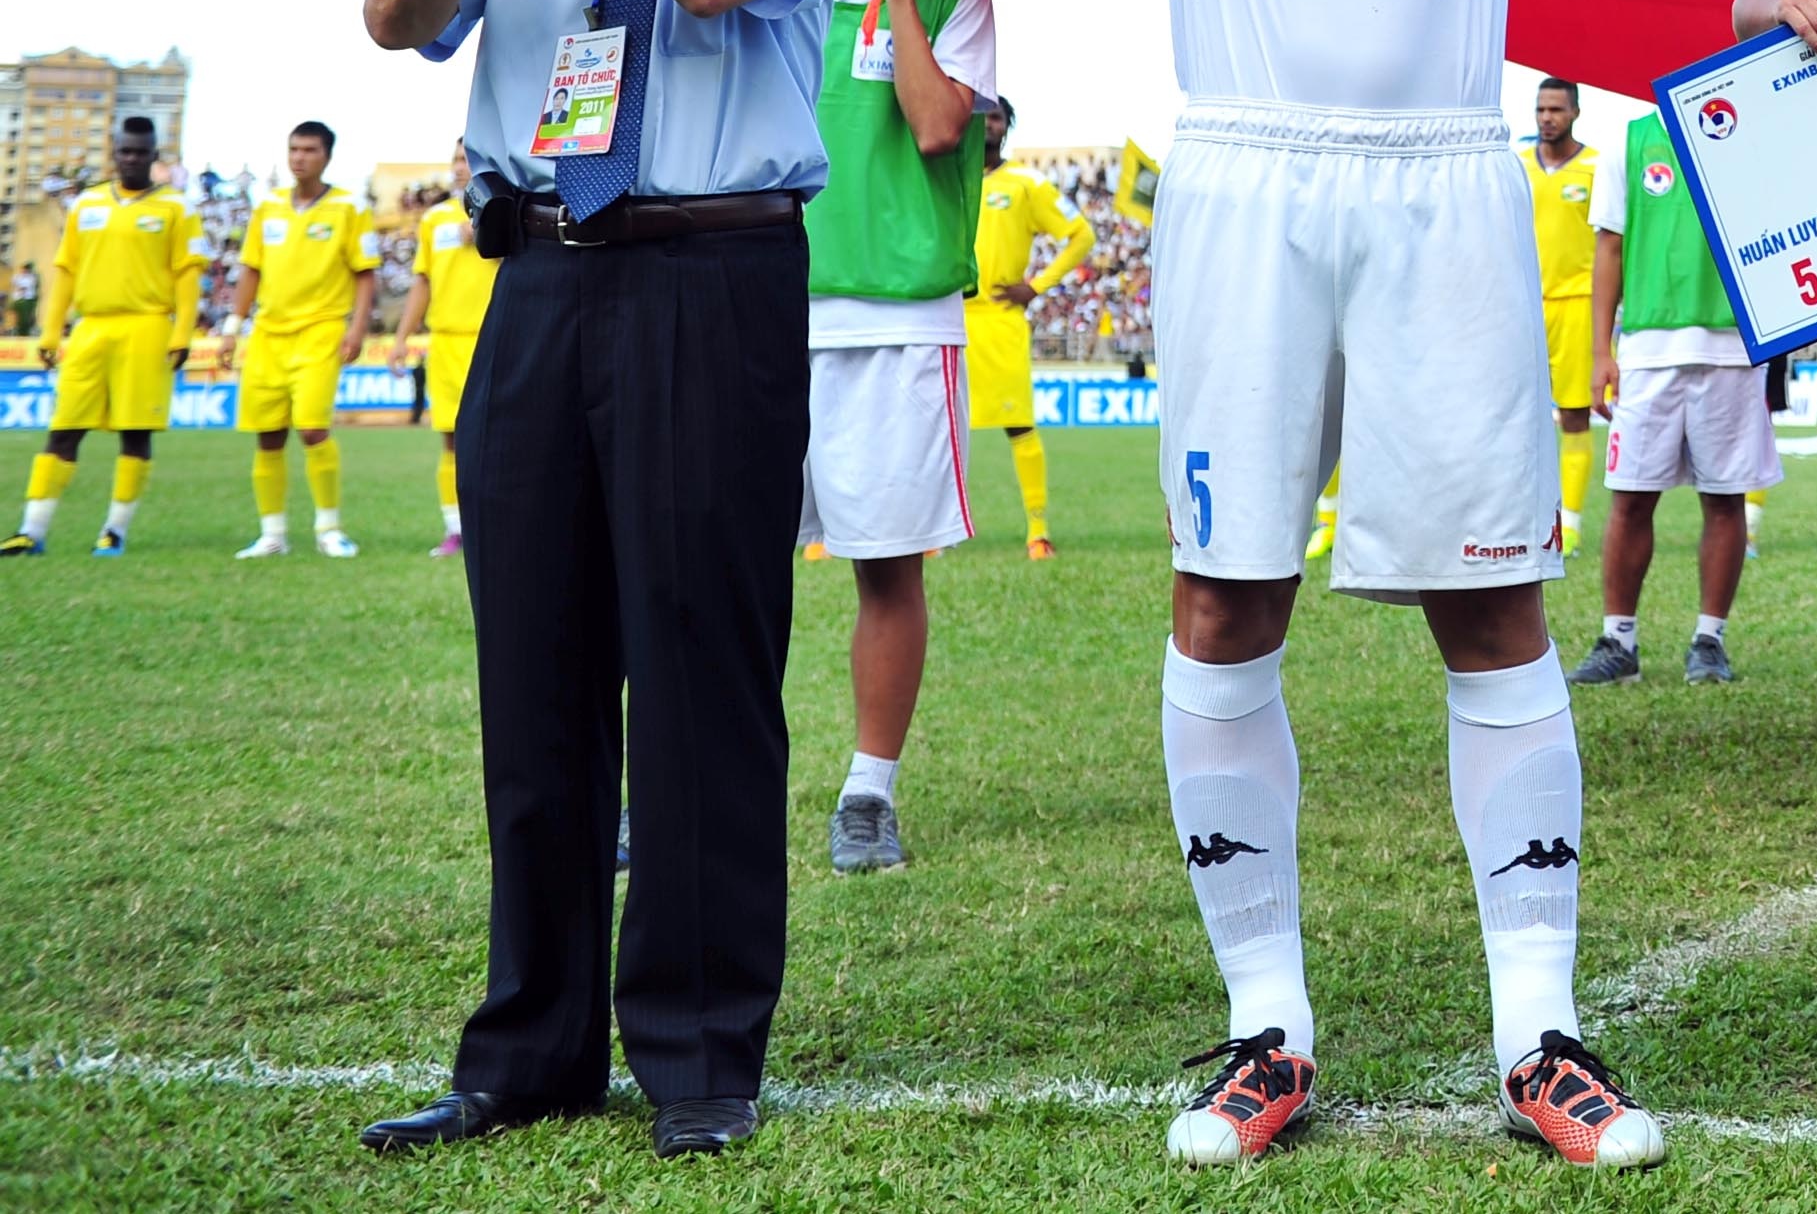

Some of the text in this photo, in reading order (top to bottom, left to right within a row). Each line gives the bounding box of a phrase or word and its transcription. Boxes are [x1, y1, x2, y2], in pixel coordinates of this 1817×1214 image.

[554, 68, 617, 87] BAN TỔ CHỨC
[578, 99, 606, 115] 2011
[1738, 229, 1786, 267] HUẤN
[1185, 450, 1212, 549] 5
[1463, 544, 1528, 559] Kappa
